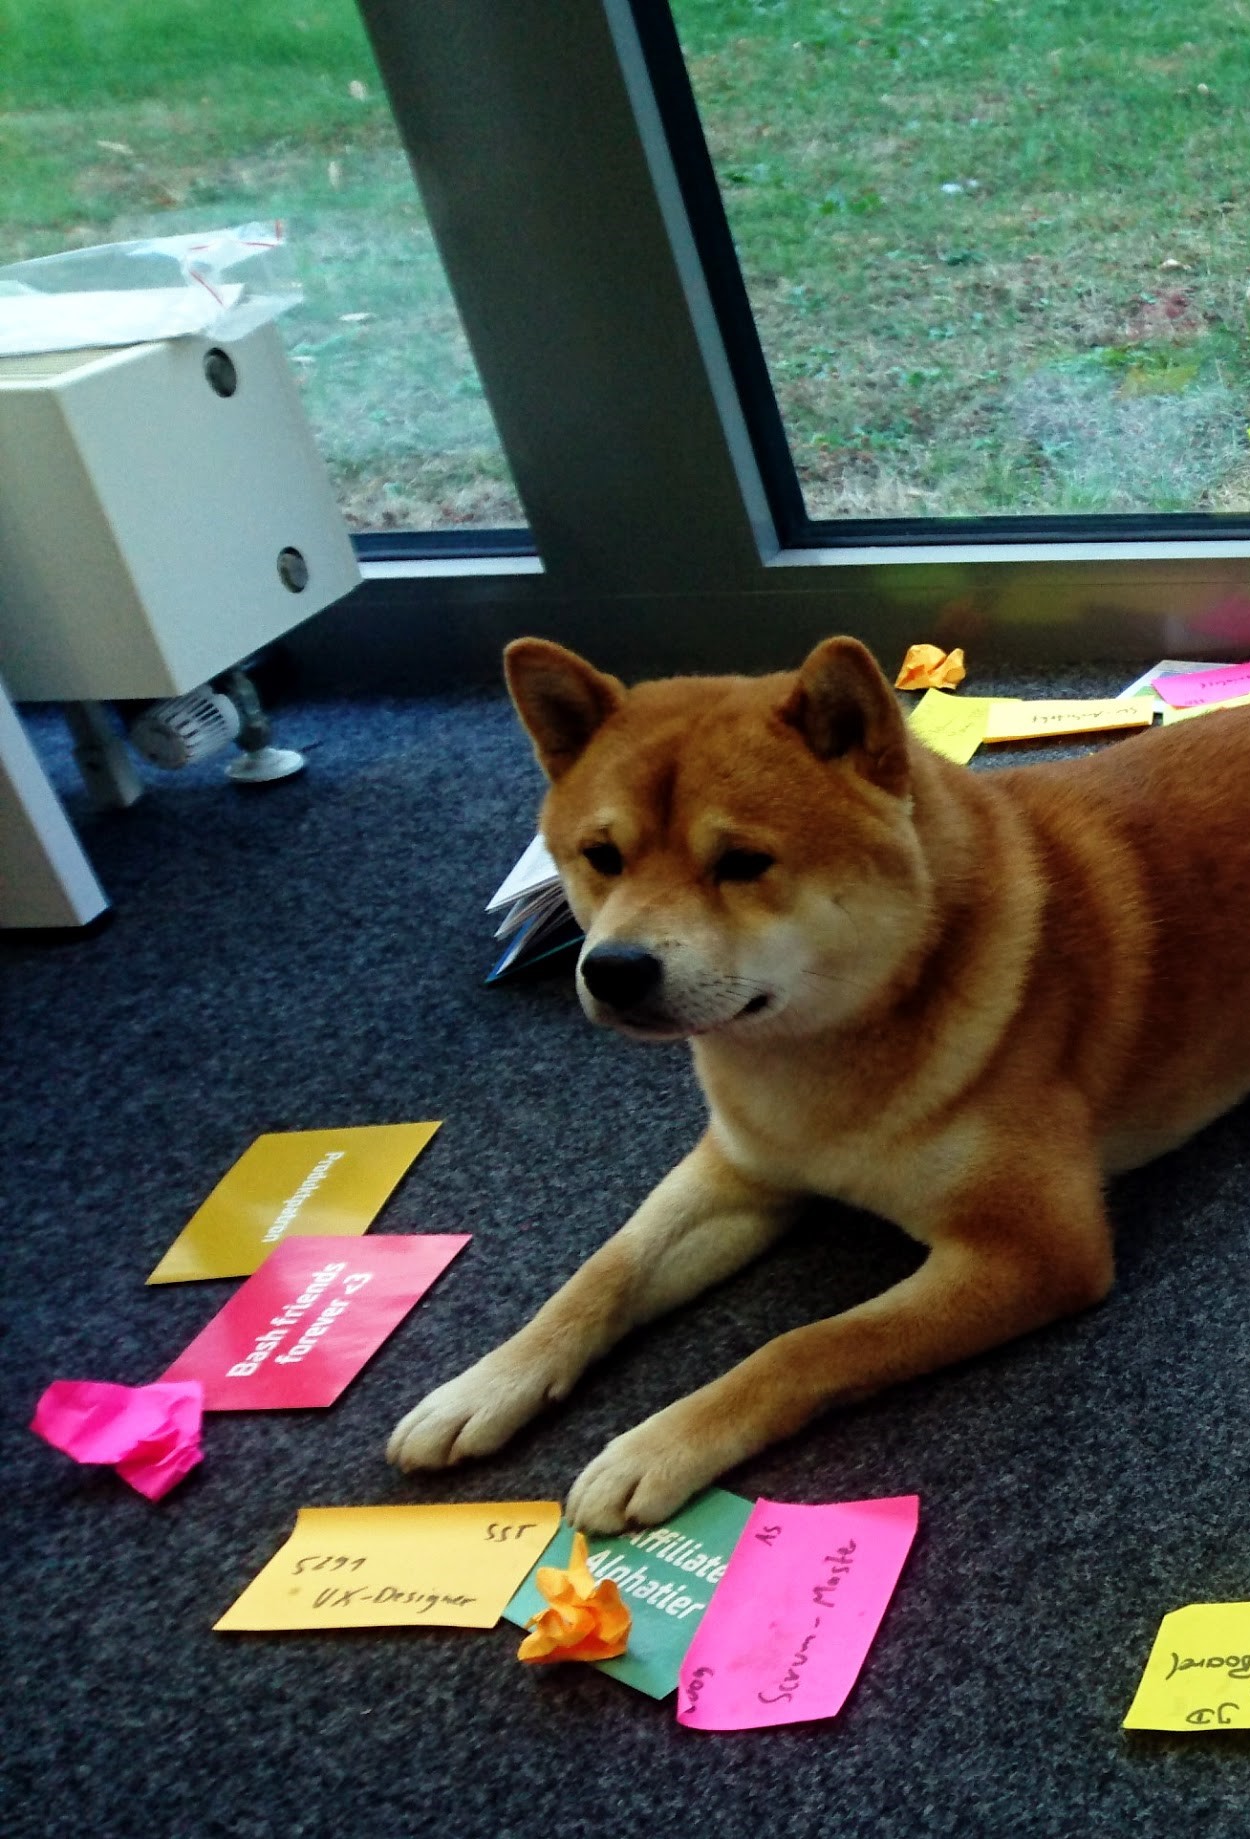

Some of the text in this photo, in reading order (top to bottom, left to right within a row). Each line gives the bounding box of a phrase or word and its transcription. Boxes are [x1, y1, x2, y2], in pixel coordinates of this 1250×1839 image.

[225, 1261, 347, 1377] Bash friends
[274, 1298, 351, 1364] forever
